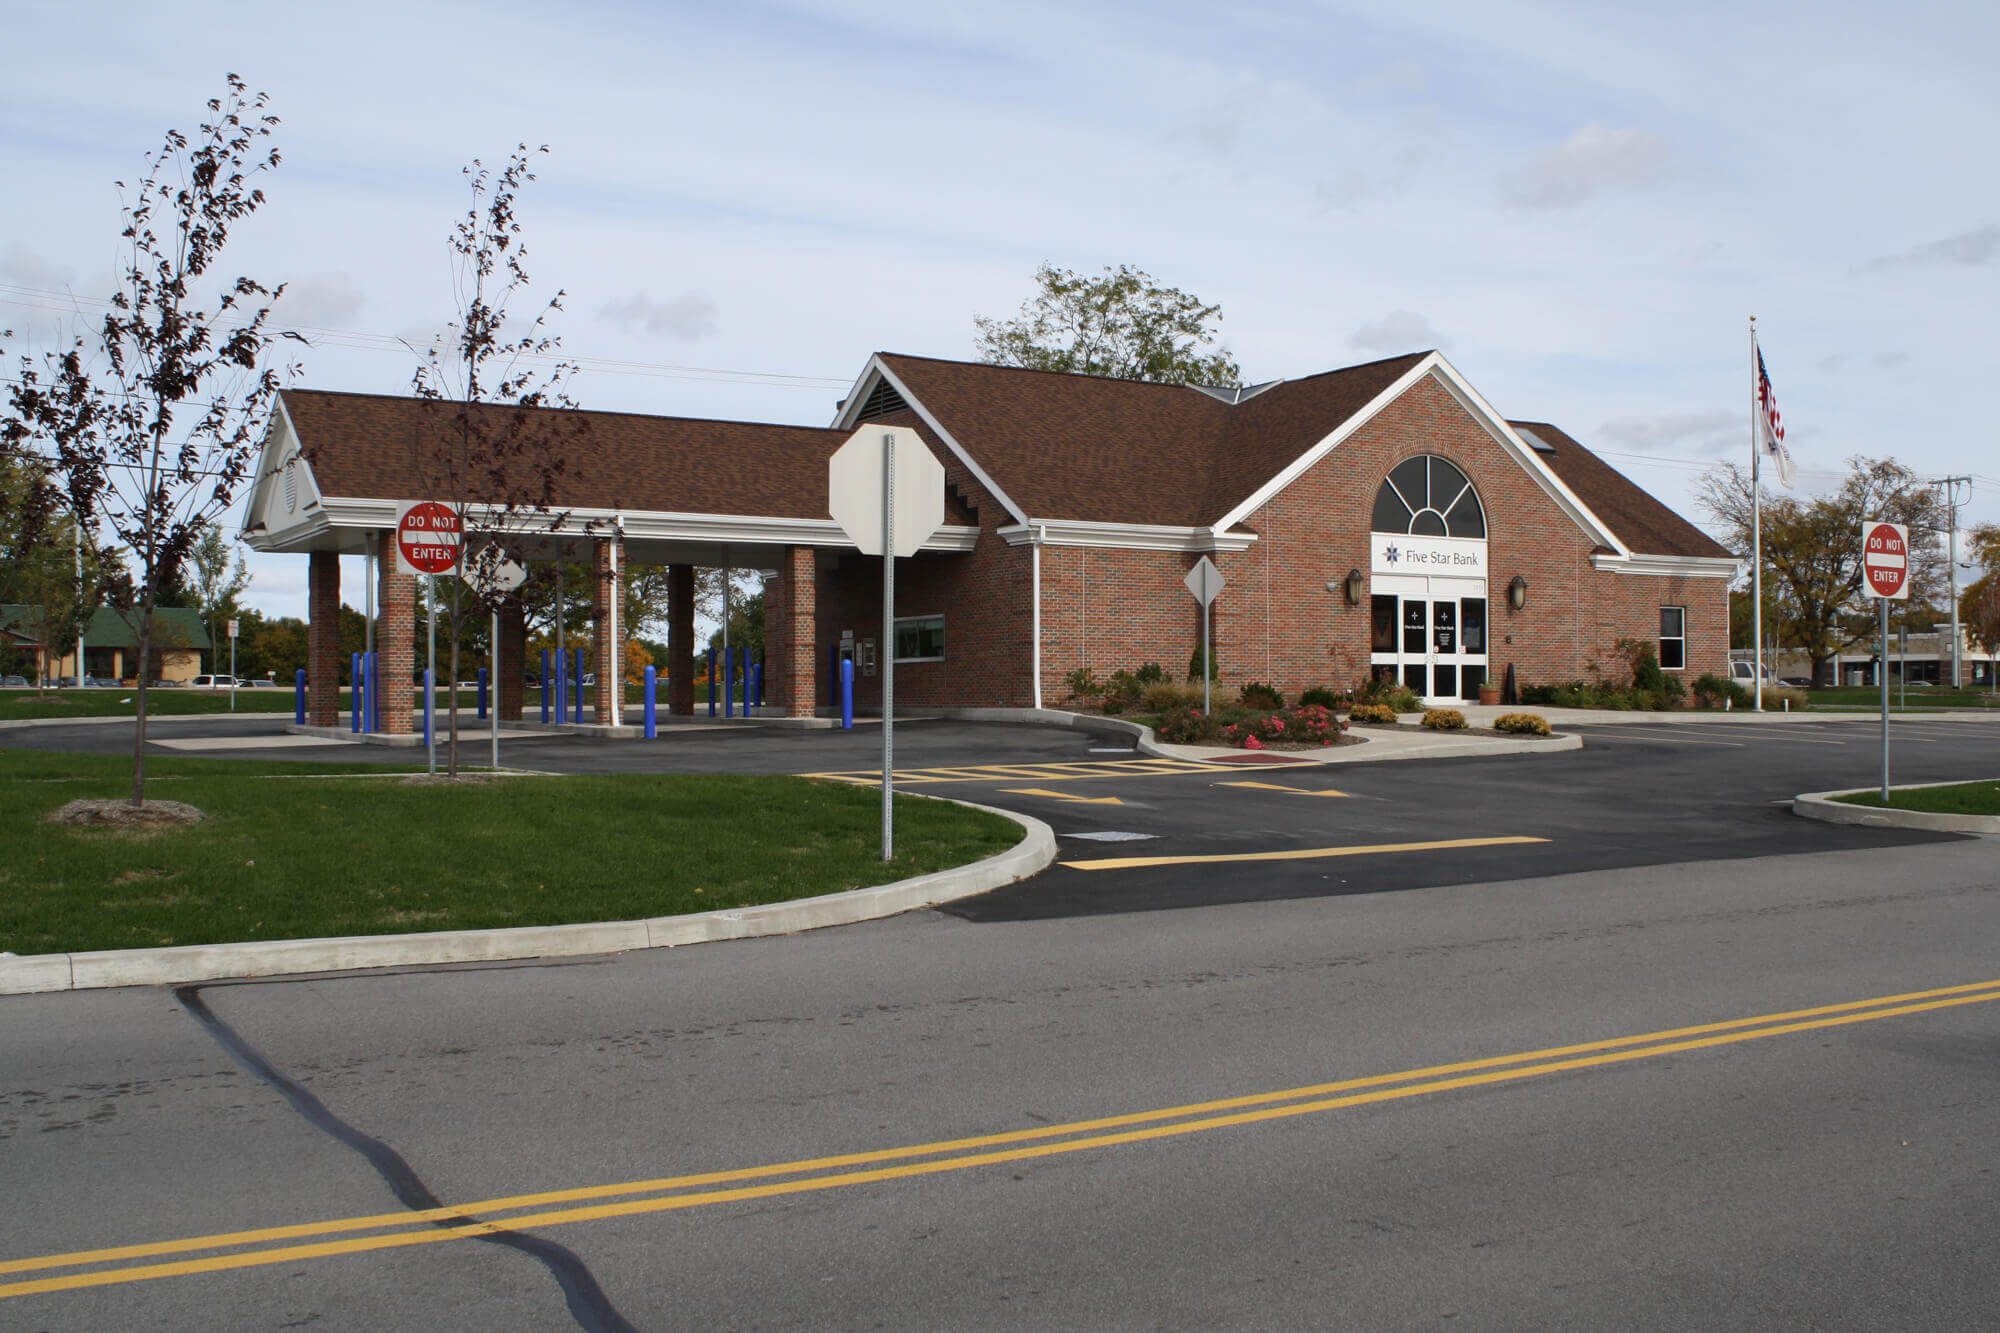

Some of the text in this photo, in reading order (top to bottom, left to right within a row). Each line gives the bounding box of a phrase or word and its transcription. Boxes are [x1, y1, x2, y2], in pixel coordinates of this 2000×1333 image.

[408, 516, 456, 528] DO NOT
[1870, 538, 1901, 551] DO NOT
[412, 547, 452, 560] ENTER
[1406, 550, 1479, 566] Five Star Bank
[1873, 570, 1899, 583] ENTER
